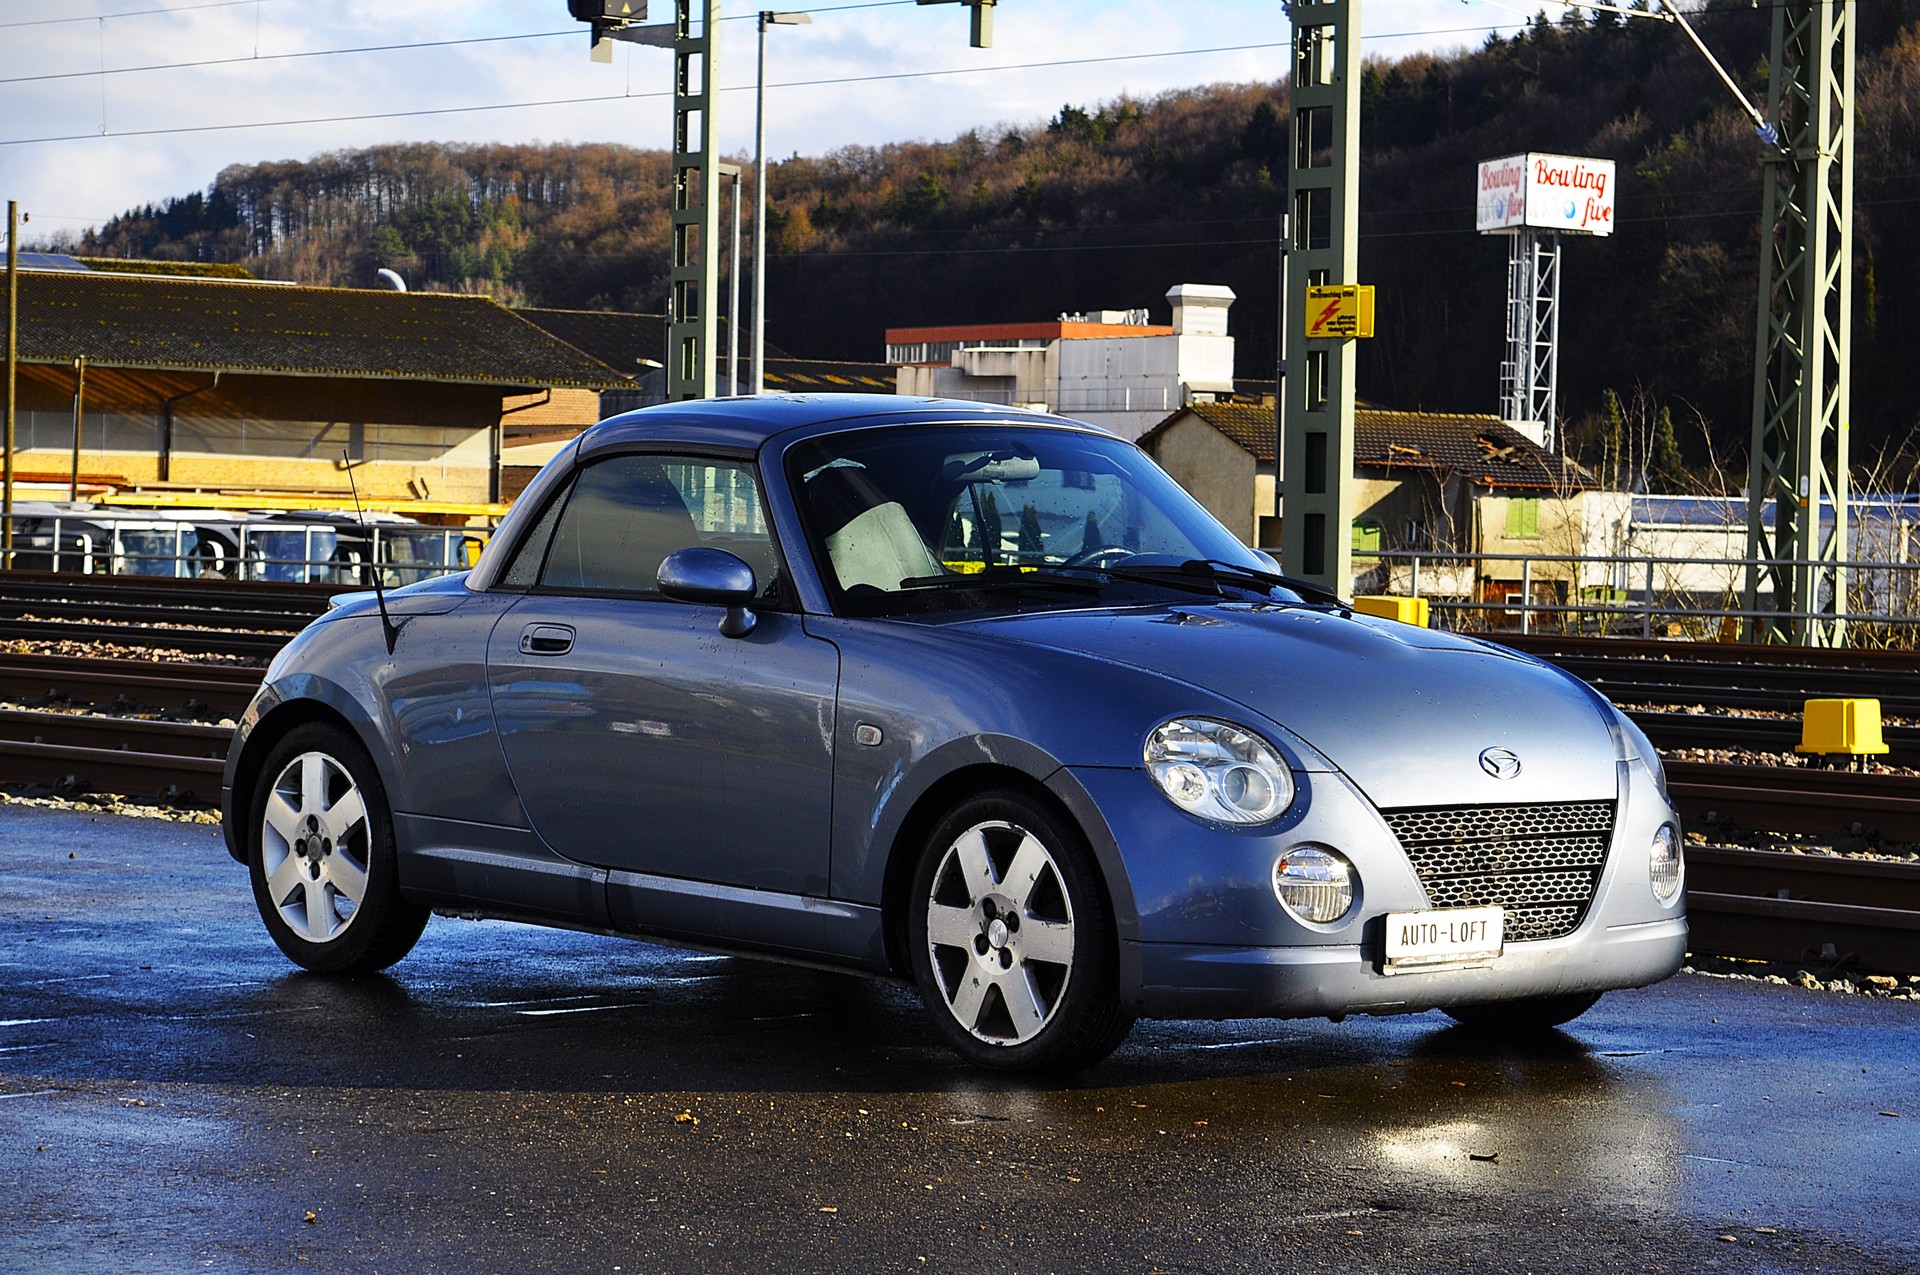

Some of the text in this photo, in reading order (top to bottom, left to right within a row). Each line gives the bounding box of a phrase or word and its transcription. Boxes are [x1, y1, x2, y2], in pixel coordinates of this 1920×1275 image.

[1481, 161, 1521, 193] Bowling
[1535, 159, 1607, 198] Bowling
[1505, 192, 1523, 225] five
[1581, 196, 1612, 227] five
[1401, 920, 1488, 946] AUTO-LOFT
